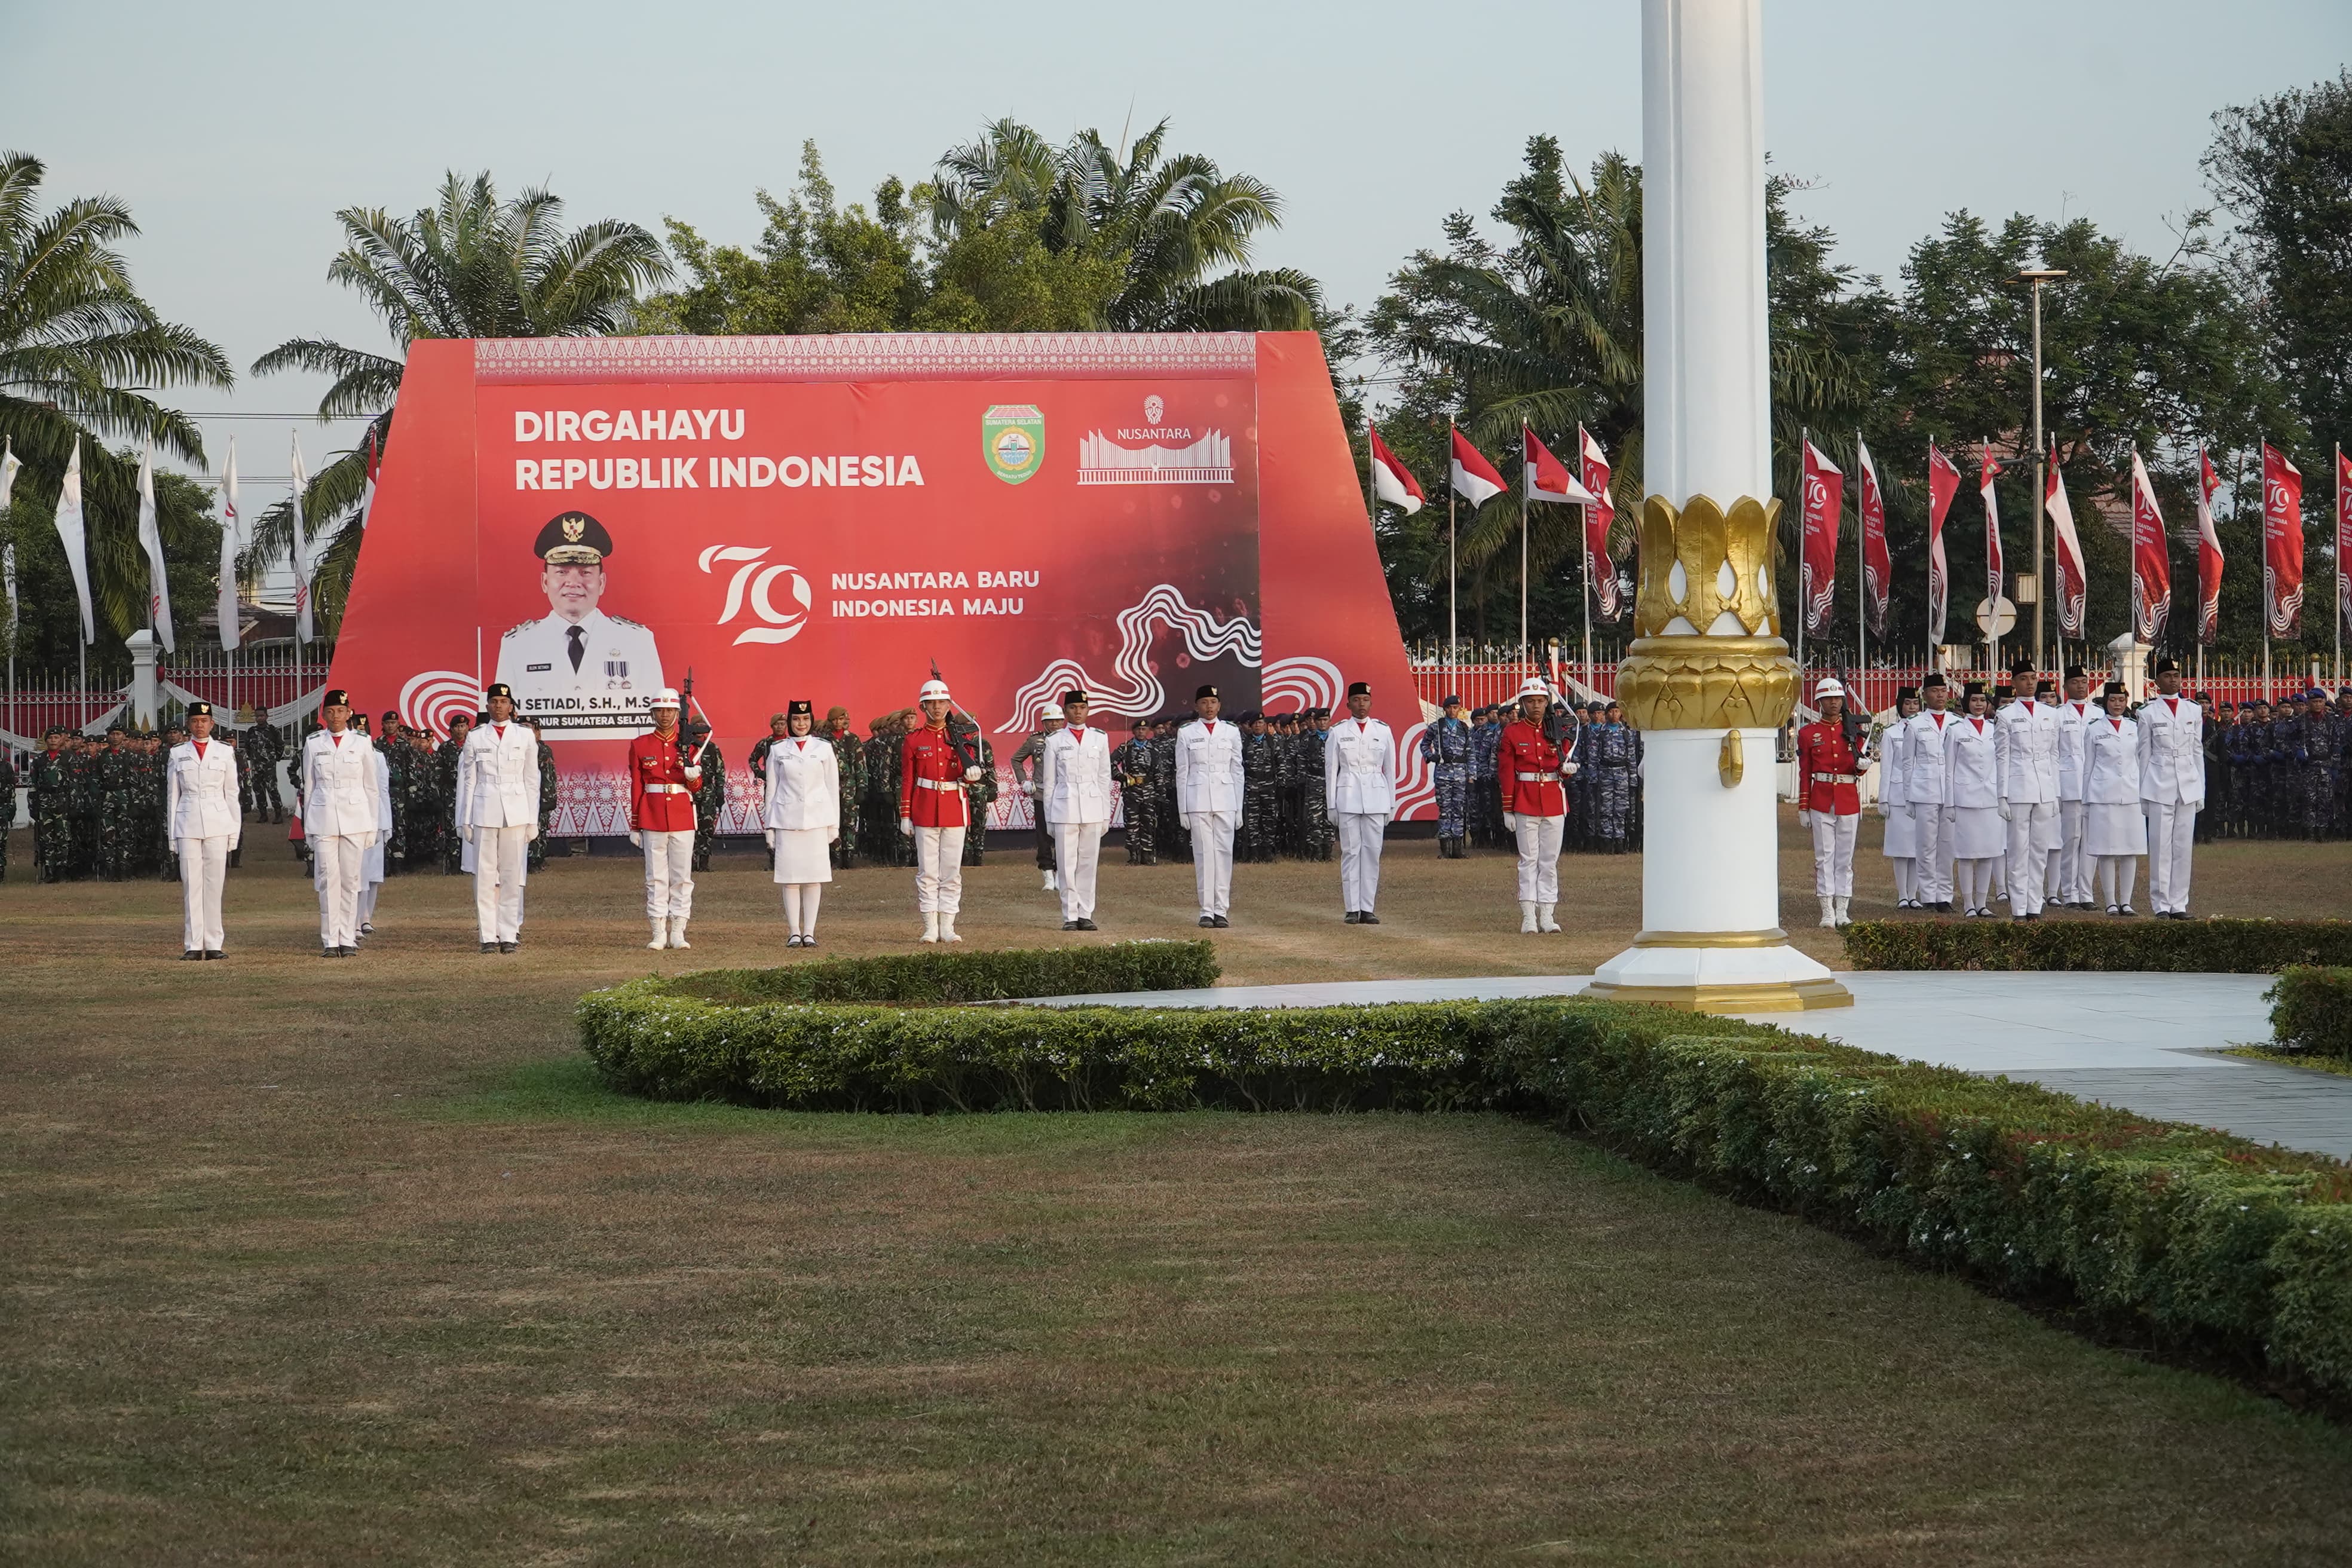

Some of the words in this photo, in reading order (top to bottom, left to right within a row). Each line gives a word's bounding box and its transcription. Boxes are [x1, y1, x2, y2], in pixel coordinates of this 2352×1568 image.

[516, 409, 745, 442] DIRGAHAYU
[1117, 428, 1191, 439] NUSANTARA
[516, 458, 699, 490] REPUBLIK
[709, 455, 925, 488] INDONESIA
[832, 572, 969, 590] NUSANTARA
[978, 570, 1039, 587] BARU
[832, 599, 955, 617] INDONESIA
[963, 598, 1024, 615] MAJU
[525, 697, 584, 711] SETIADI,
[589, 697, 621, 709] S.H.,
[626, 696, 651, 708] M.S
[534, 717, 560, 727] NUR
[561, 716, 617, 726] SUMATERA
